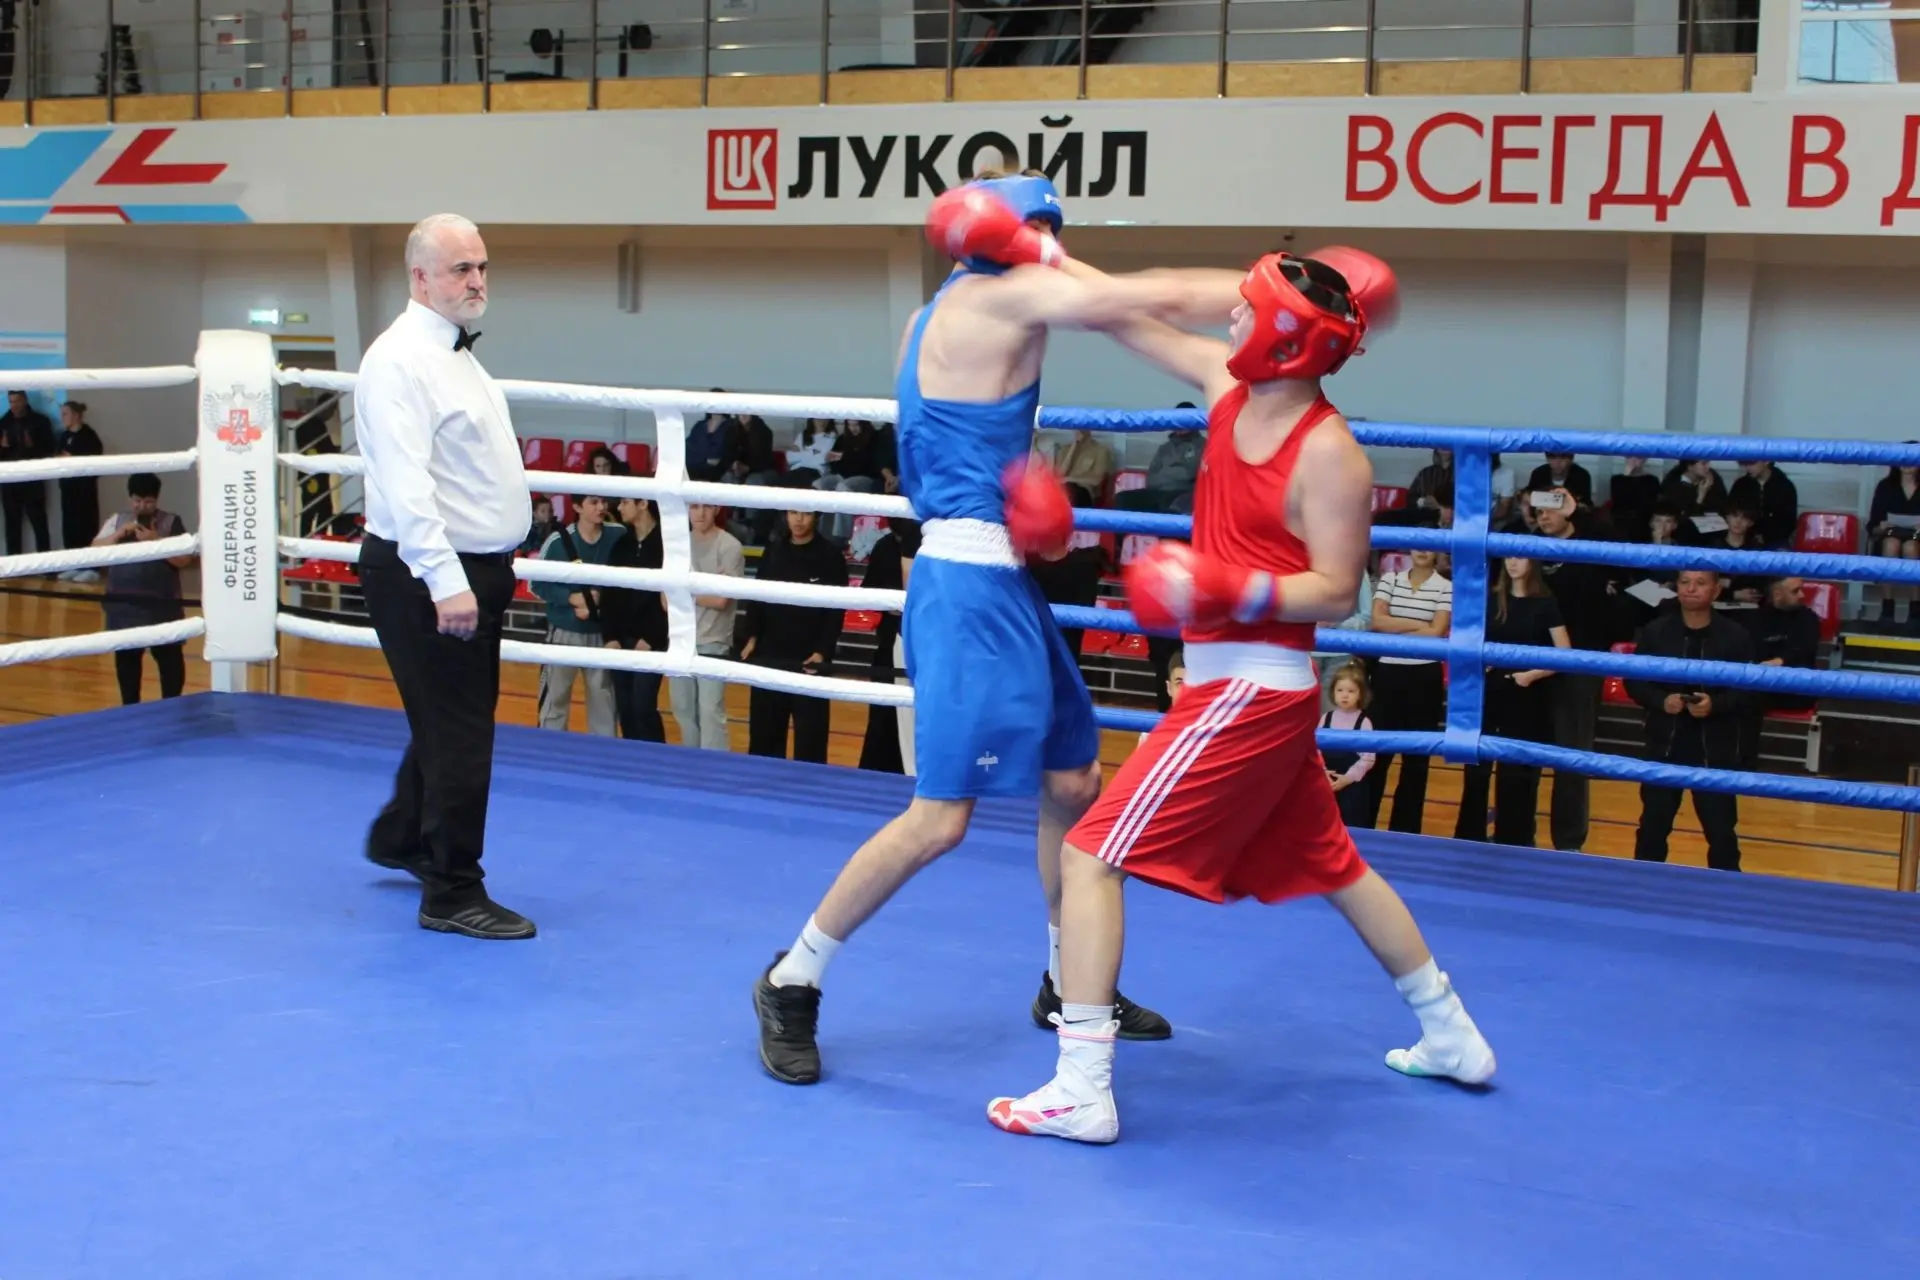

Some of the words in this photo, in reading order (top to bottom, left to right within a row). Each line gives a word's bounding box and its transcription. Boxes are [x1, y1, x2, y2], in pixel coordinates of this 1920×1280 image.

[788, 115, 1148, 199] ЛУКОЙЛ
[1345, 110, 1751, 222] ВСЕГДА
[1786, 114, 1850, 209] В
[224, 483, 240, 589] ФЕДЕРАЦИЯ
[243, 470, 257, 540] РОССИИ
[243, 545, 257, 601] БОКСА
